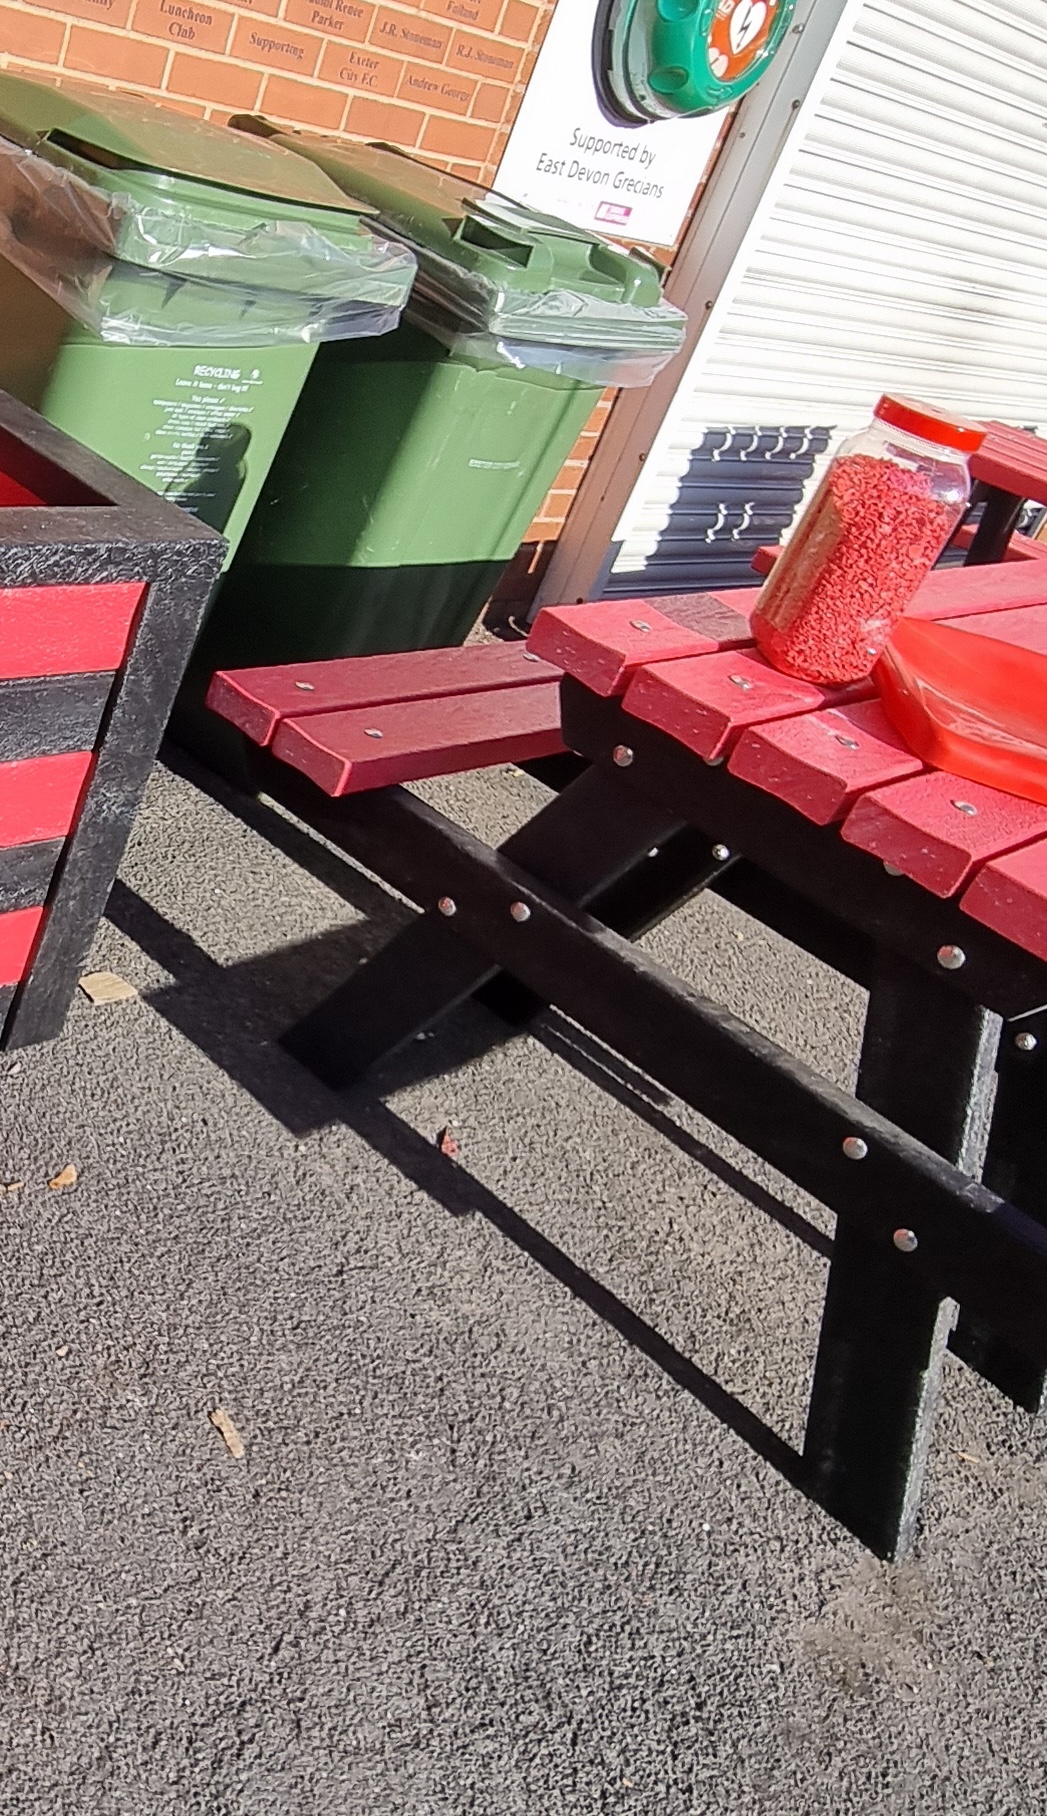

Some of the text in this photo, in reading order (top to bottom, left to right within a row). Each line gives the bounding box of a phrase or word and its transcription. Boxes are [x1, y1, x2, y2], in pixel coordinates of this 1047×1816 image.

[160, 0, 213, 26] Luncheon
[311, 9, 344, 30] Parker
[168, 21, 196, 40] Club
[249, 32, 305, 59] Supporting
[349, 51, 380, 70] Exeter
[339, 67, 358, 83] City
[569, 127, 656, 170] Supported by
[536, 152, 665, 199] East Devon Grecians
[193, 365, 241, 380] RECYCLING
